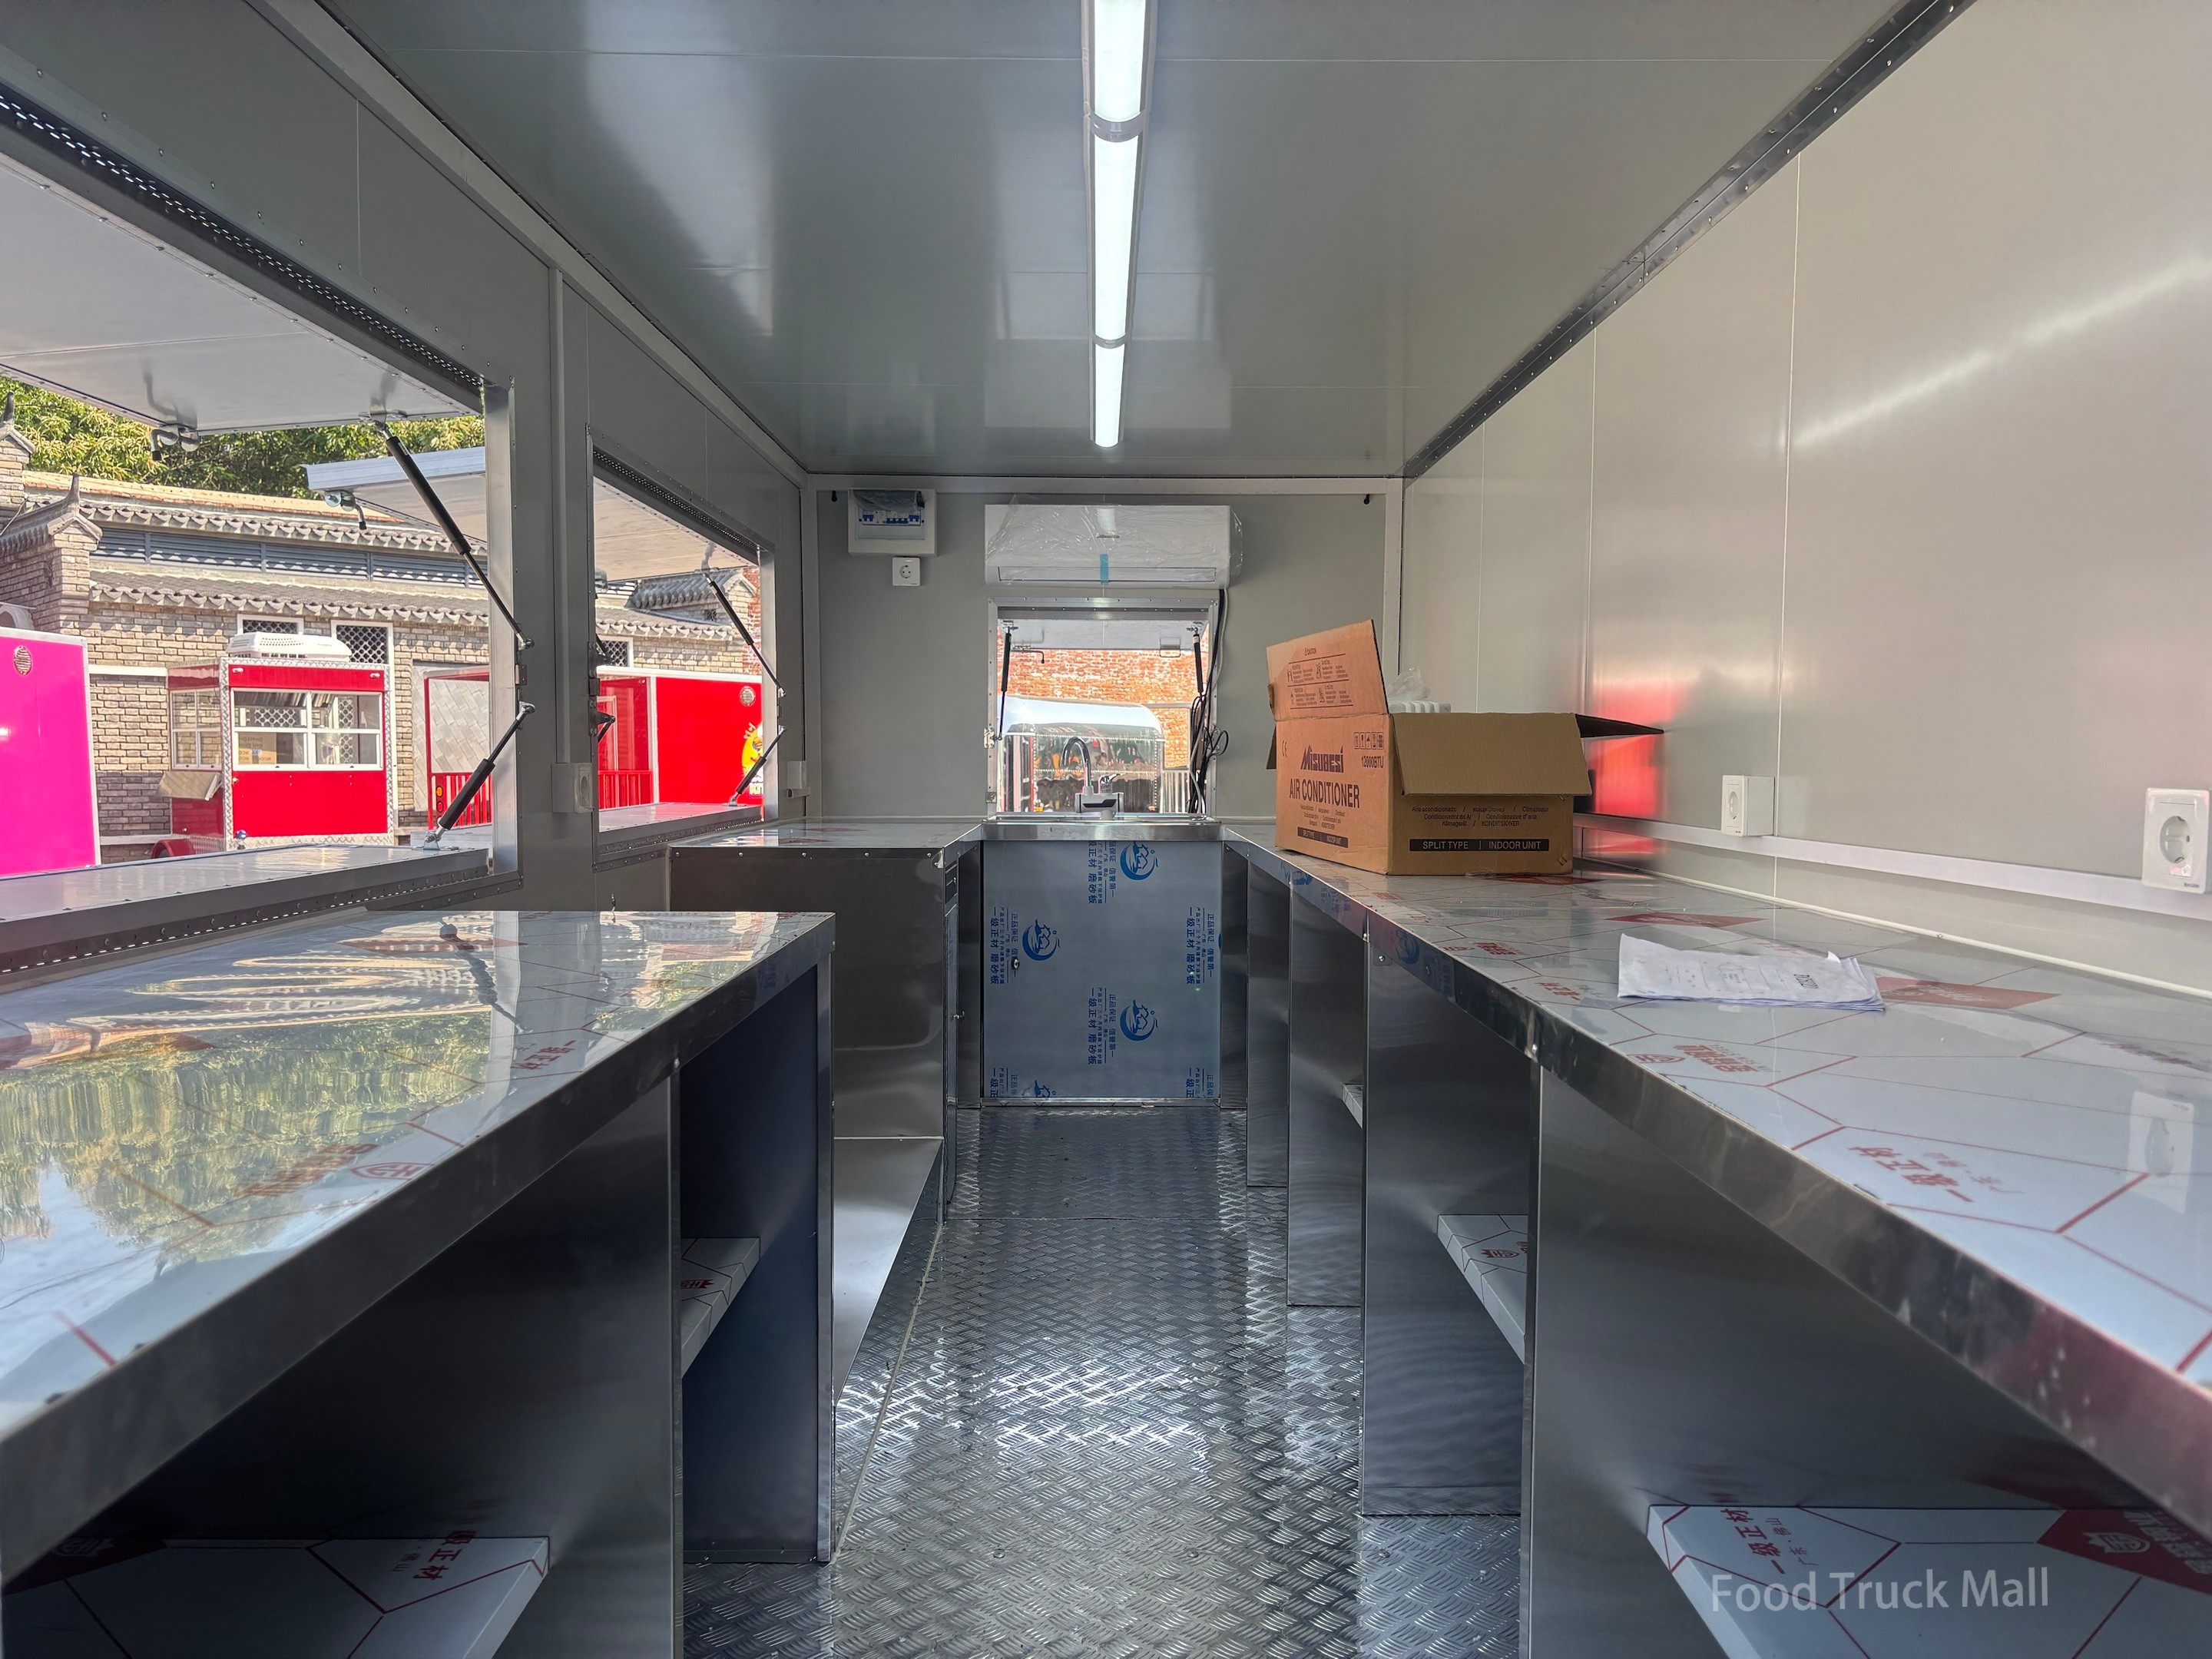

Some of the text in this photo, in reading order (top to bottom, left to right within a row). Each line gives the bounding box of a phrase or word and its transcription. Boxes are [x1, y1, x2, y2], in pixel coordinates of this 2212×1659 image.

[1290, 778, 1359, 809] AIR CONDITIONER
[1422, 841, 1541, 849] SPLIT TYPE INDOOR UNIT
[1088, 873, 1098, 904] 磨砂板
[991, 906, 999, 985] 一级正材 磨砂板
[1187, 906, 1195, 985] 一级正材 磨砂板
[1088, 987, 1097, 1065] 一级正材 磨砂板
[1720, 1508, 1786, 1574] 一级正材
